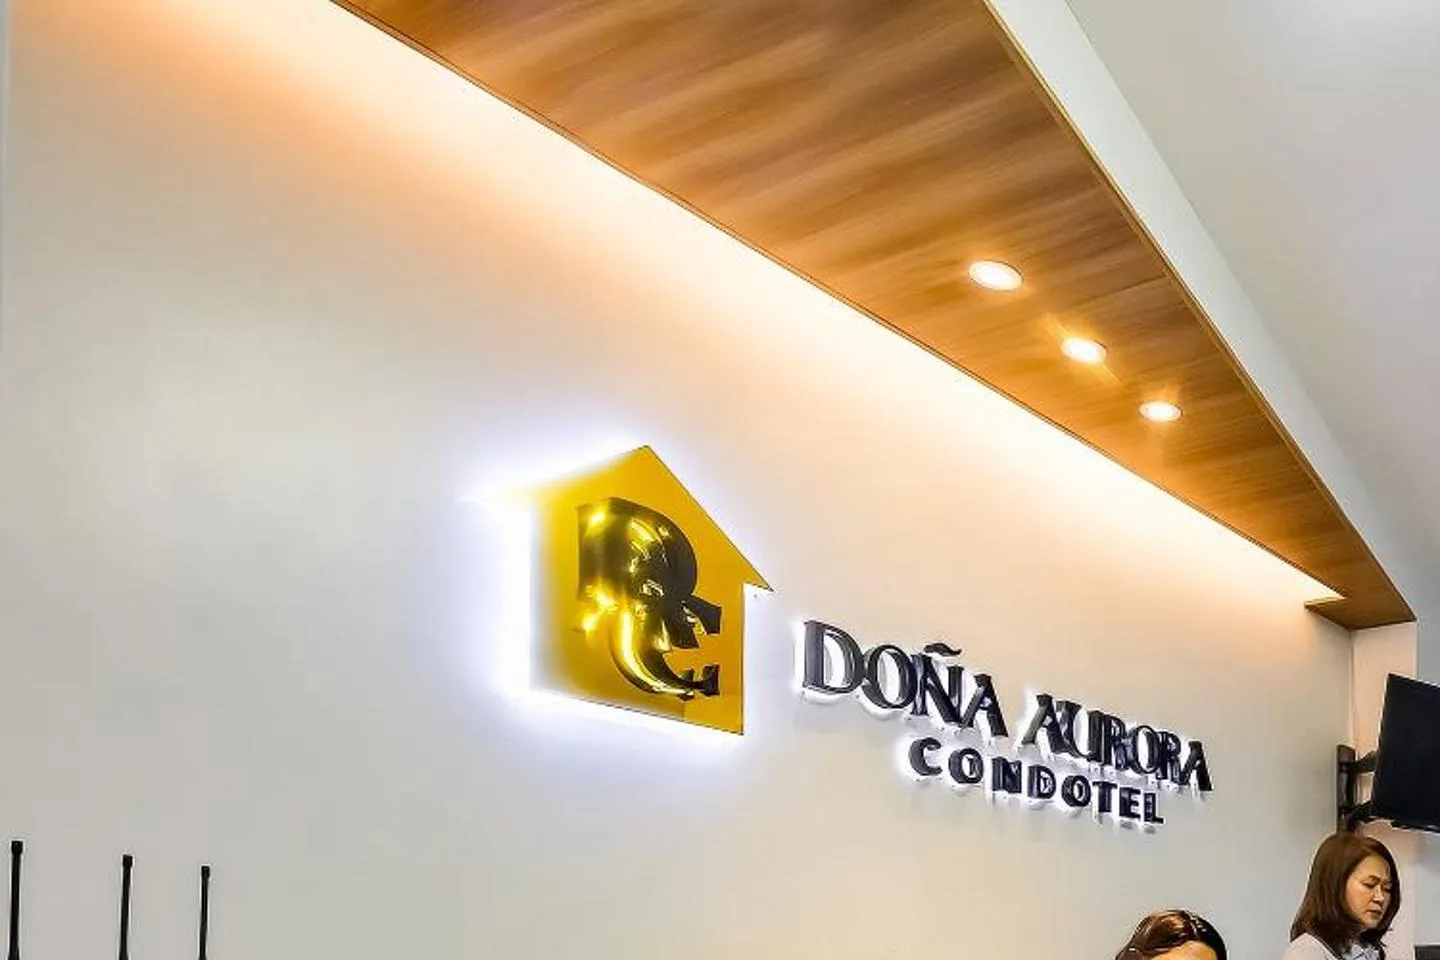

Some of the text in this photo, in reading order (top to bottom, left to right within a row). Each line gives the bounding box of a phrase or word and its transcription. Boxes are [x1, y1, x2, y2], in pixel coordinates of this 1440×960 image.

[802, 620, 1213, 792] DOÑA AURORA
[908, 737, 1166, 825] CONDOTEL
